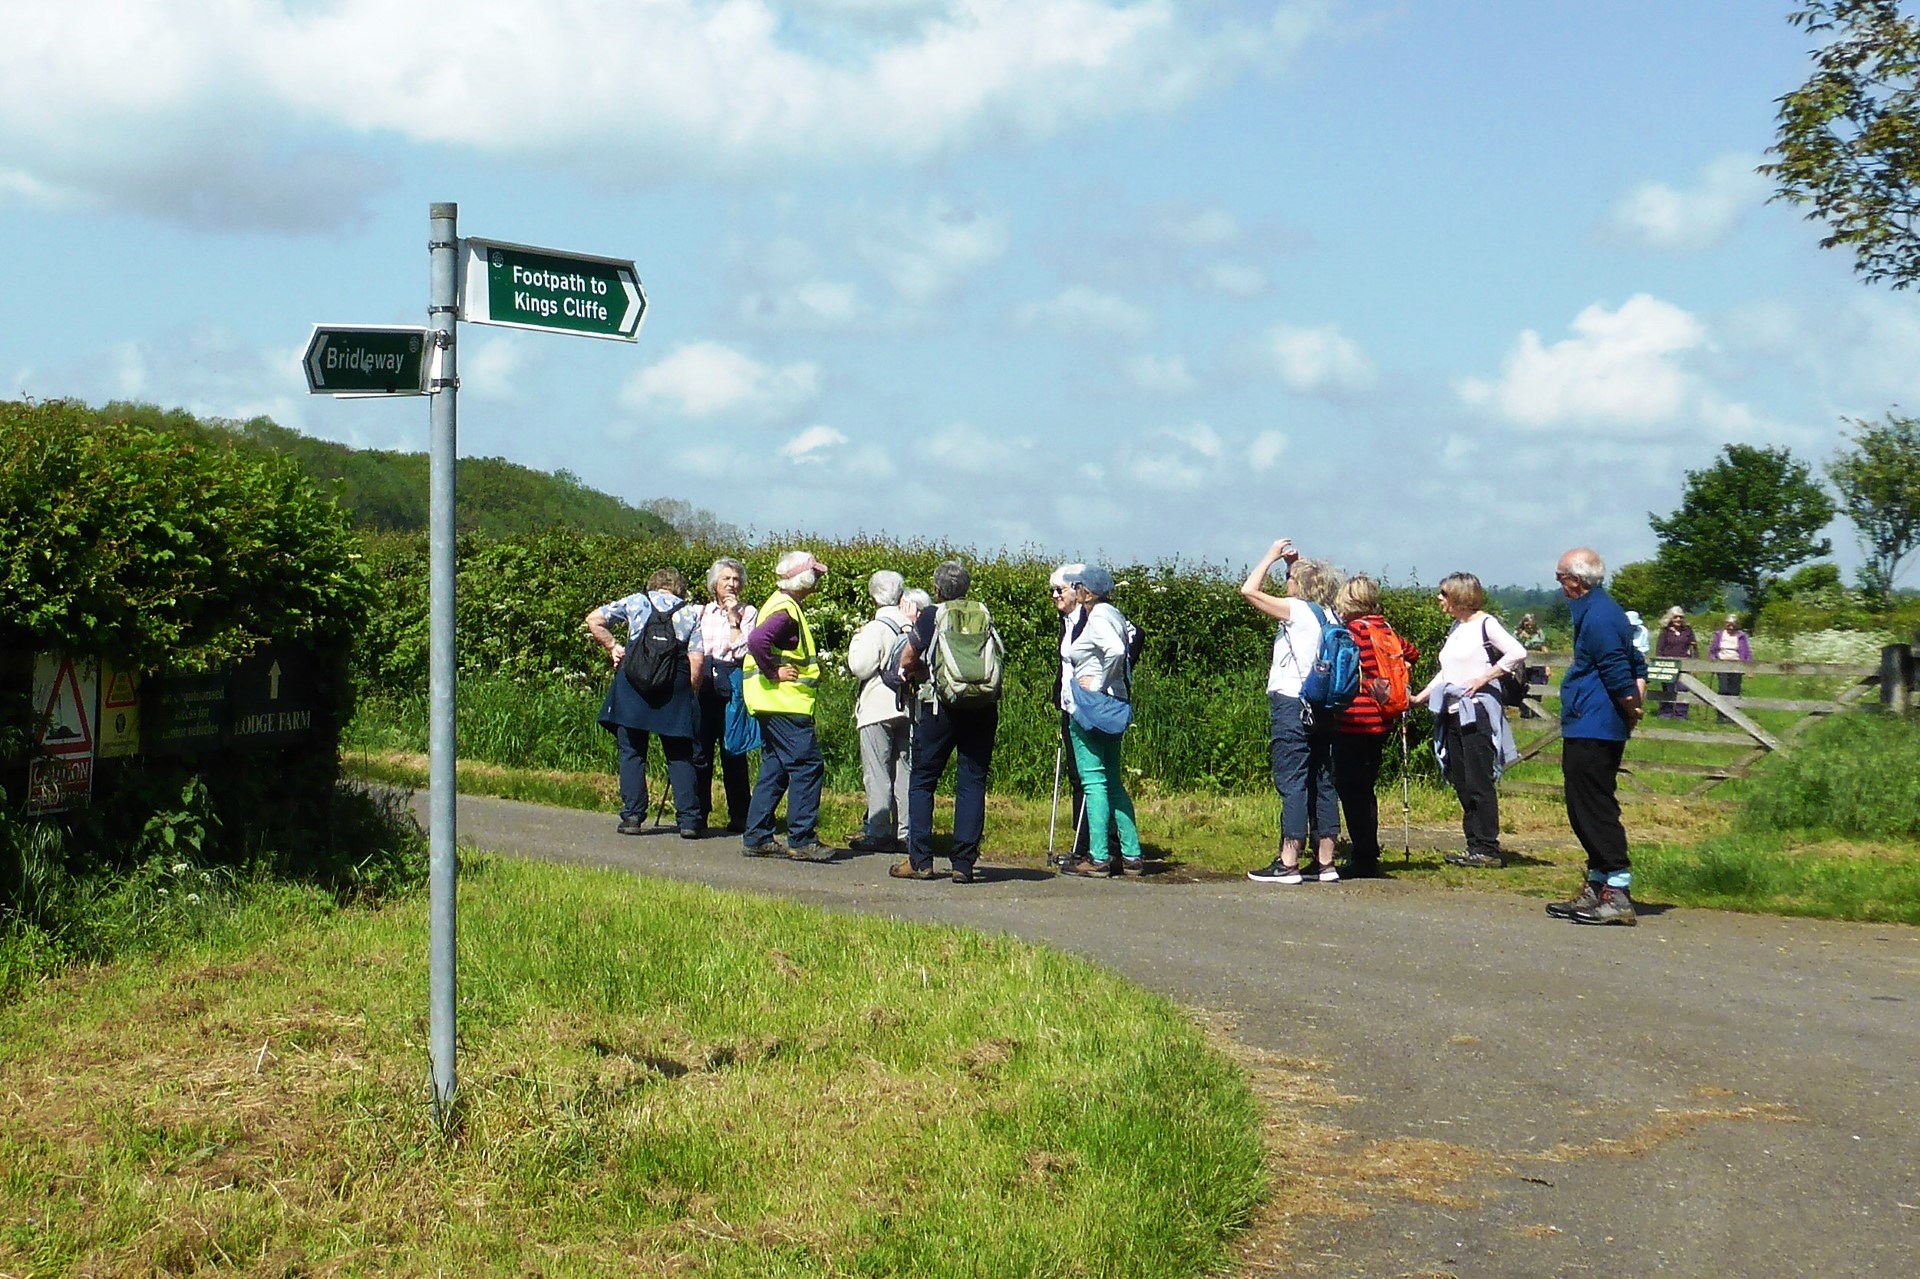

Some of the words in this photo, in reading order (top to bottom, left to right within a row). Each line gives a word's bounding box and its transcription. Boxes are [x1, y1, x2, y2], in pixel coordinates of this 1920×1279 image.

[513, 265, 586, 293] Footpath
[590, 276, 607, 295] to
[514, 291, 558, 317] Kings
[563, 297, 608, 321] Cliffe
[326, 347, 404, 374] Bridleway
[234, 712, 275, 736] LODGE
[278, 710, 311, 731] FARM
